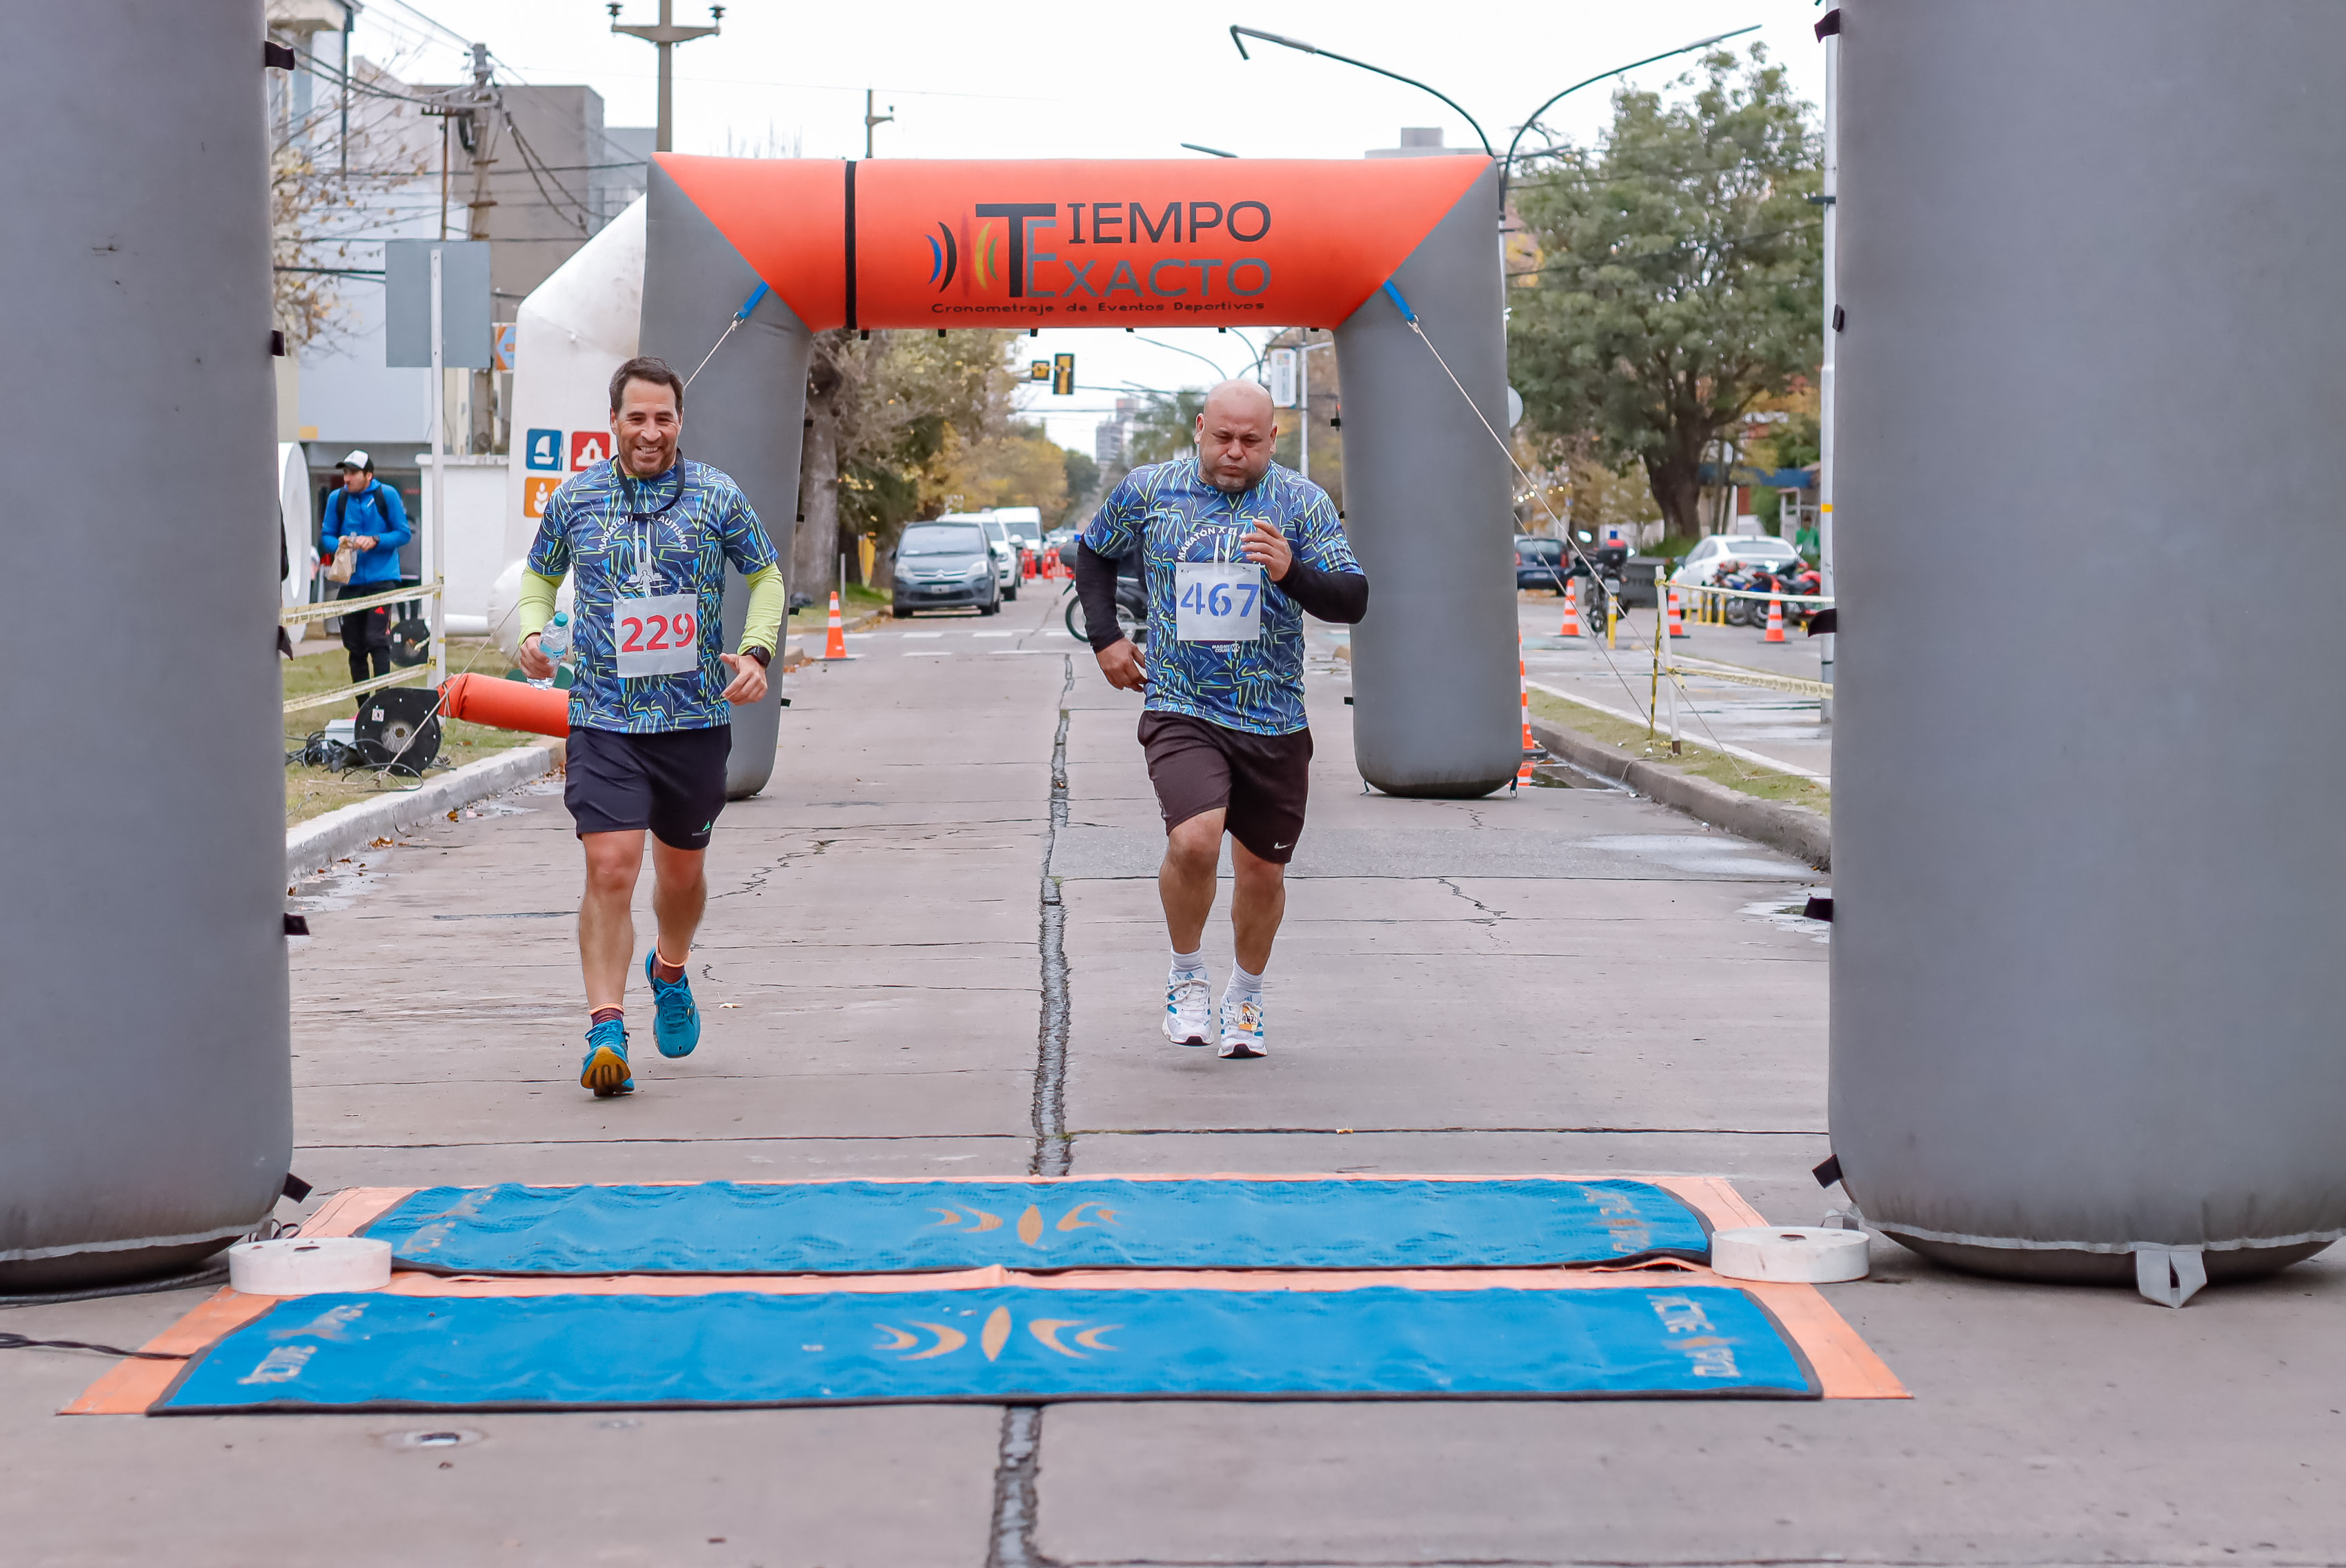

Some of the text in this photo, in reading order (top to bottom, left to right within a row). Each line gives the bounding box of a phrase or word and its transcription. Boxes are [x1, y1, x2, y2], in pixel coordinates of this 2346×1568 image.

[975, 200, 1271, 298] TIEMPO
[1026, 219, 1271, 298] EXACTO
[931, 301, 1264, 316] Cronometraje de Eventos Deportivos
[657, 515, 688, 551] AUTISMO
[1177, 526, 1215, 562] MARATÓN
[1180, 582, 1260, 617] 467
[622, 613, 695, 653] 229
